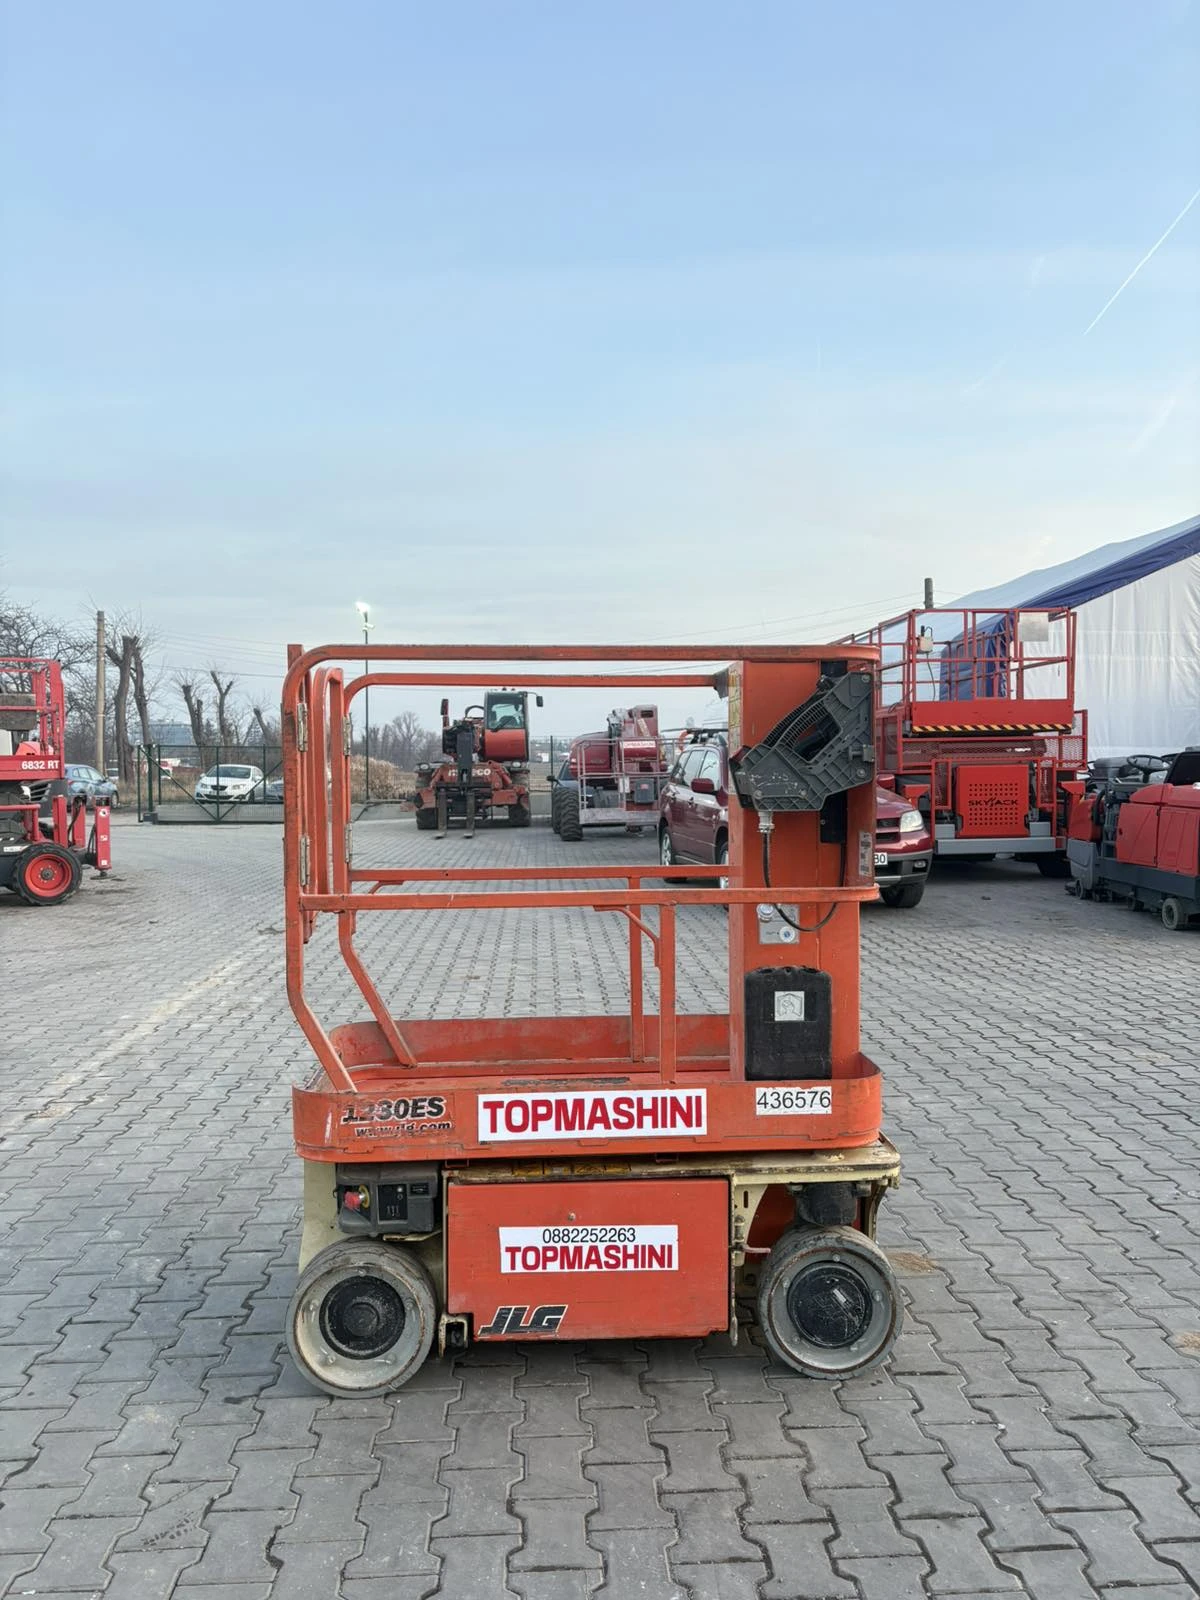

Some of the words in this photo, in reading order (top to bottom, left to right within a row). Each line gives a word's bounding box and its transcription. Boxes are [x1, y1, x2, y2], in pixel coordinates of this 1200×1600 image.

[21, 760, 46, 770] 6832
[47, 760, 60, 769] RT
[756, 1090, 832, 1110] 436576
[483, 1095, 703, 1133] TOPMASHINI
[542, 1227, 636, 1244] 0882252263
[505, 1244, 673, 1271] TOPMASHINI
[478, 1304, 568, 1336] JLG
